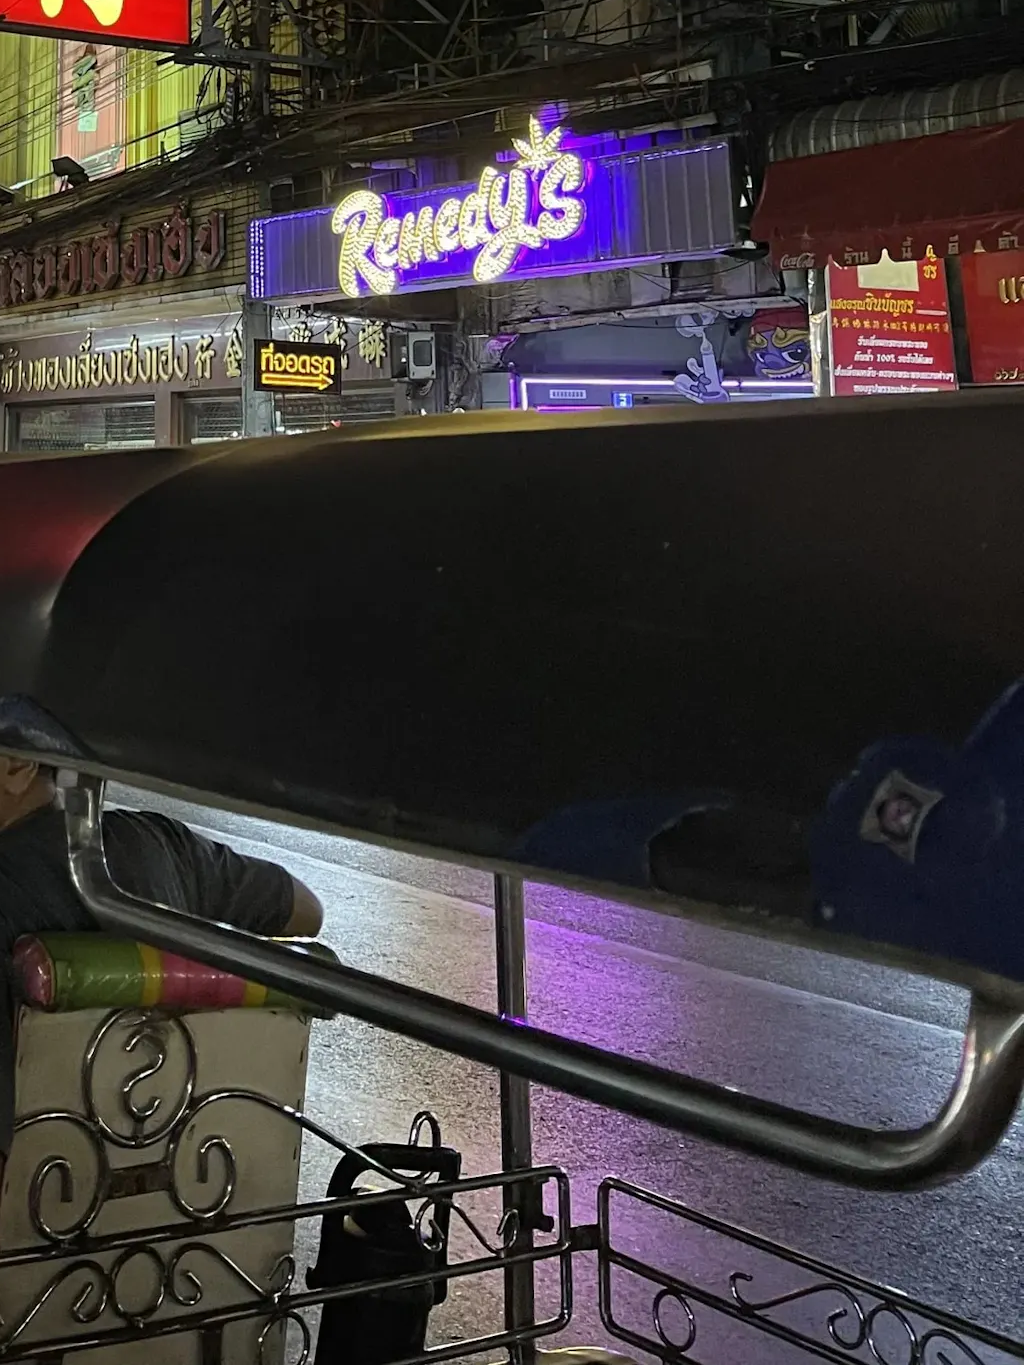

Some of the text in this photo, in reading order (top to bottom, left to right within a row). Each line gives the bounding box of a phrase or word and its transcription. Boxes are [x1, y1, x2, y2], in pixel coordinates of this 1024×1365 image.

[260, 341, 336, 376] ที่จอดรถ
[876, 353, 896, 364] 100%
